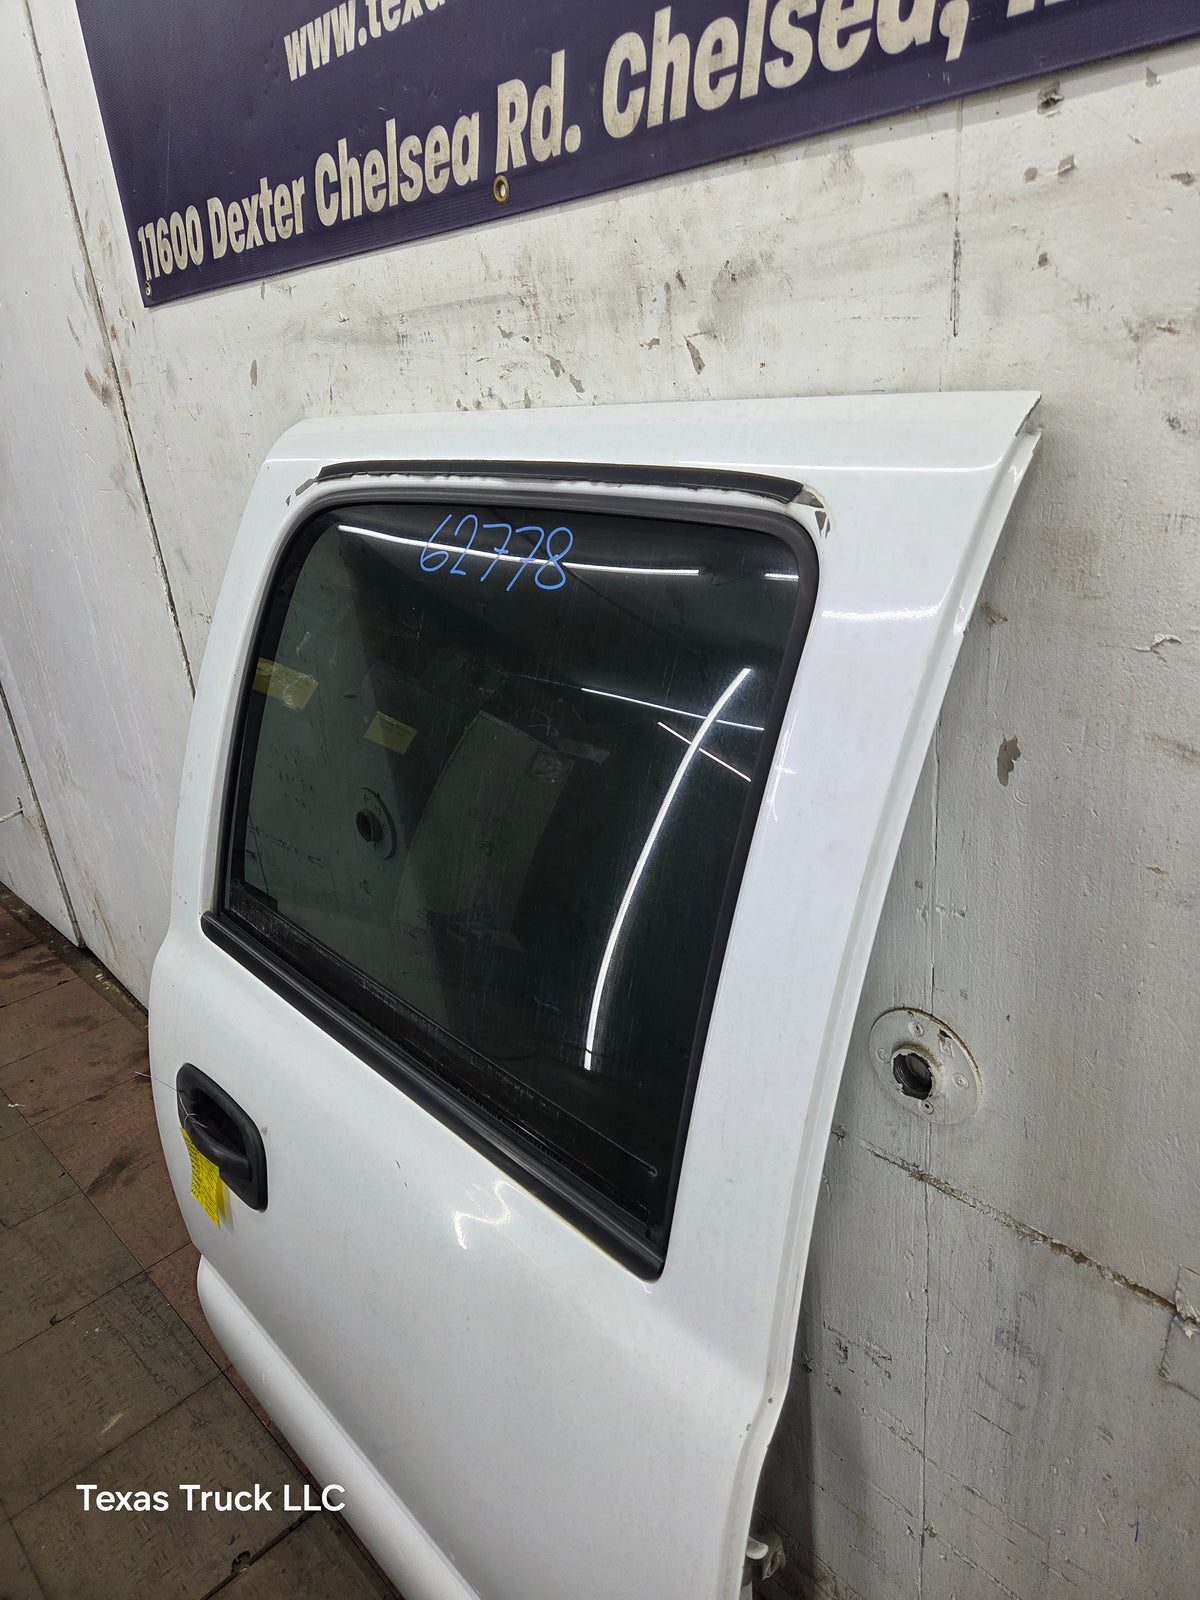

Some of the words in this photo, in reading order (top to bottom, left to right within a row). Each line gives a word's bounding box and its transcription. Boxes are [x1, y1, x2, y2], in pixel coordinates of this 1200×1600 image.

[283, 0, 446, 82] www.te
[137, 204, 204, 281] 11600
[206, 176, 306, 260] Dexter
[314, 111, 480, 228] Chelsea
[495, 49, 582, 174] Rd.
[420, 513, 574, 591] 62778
